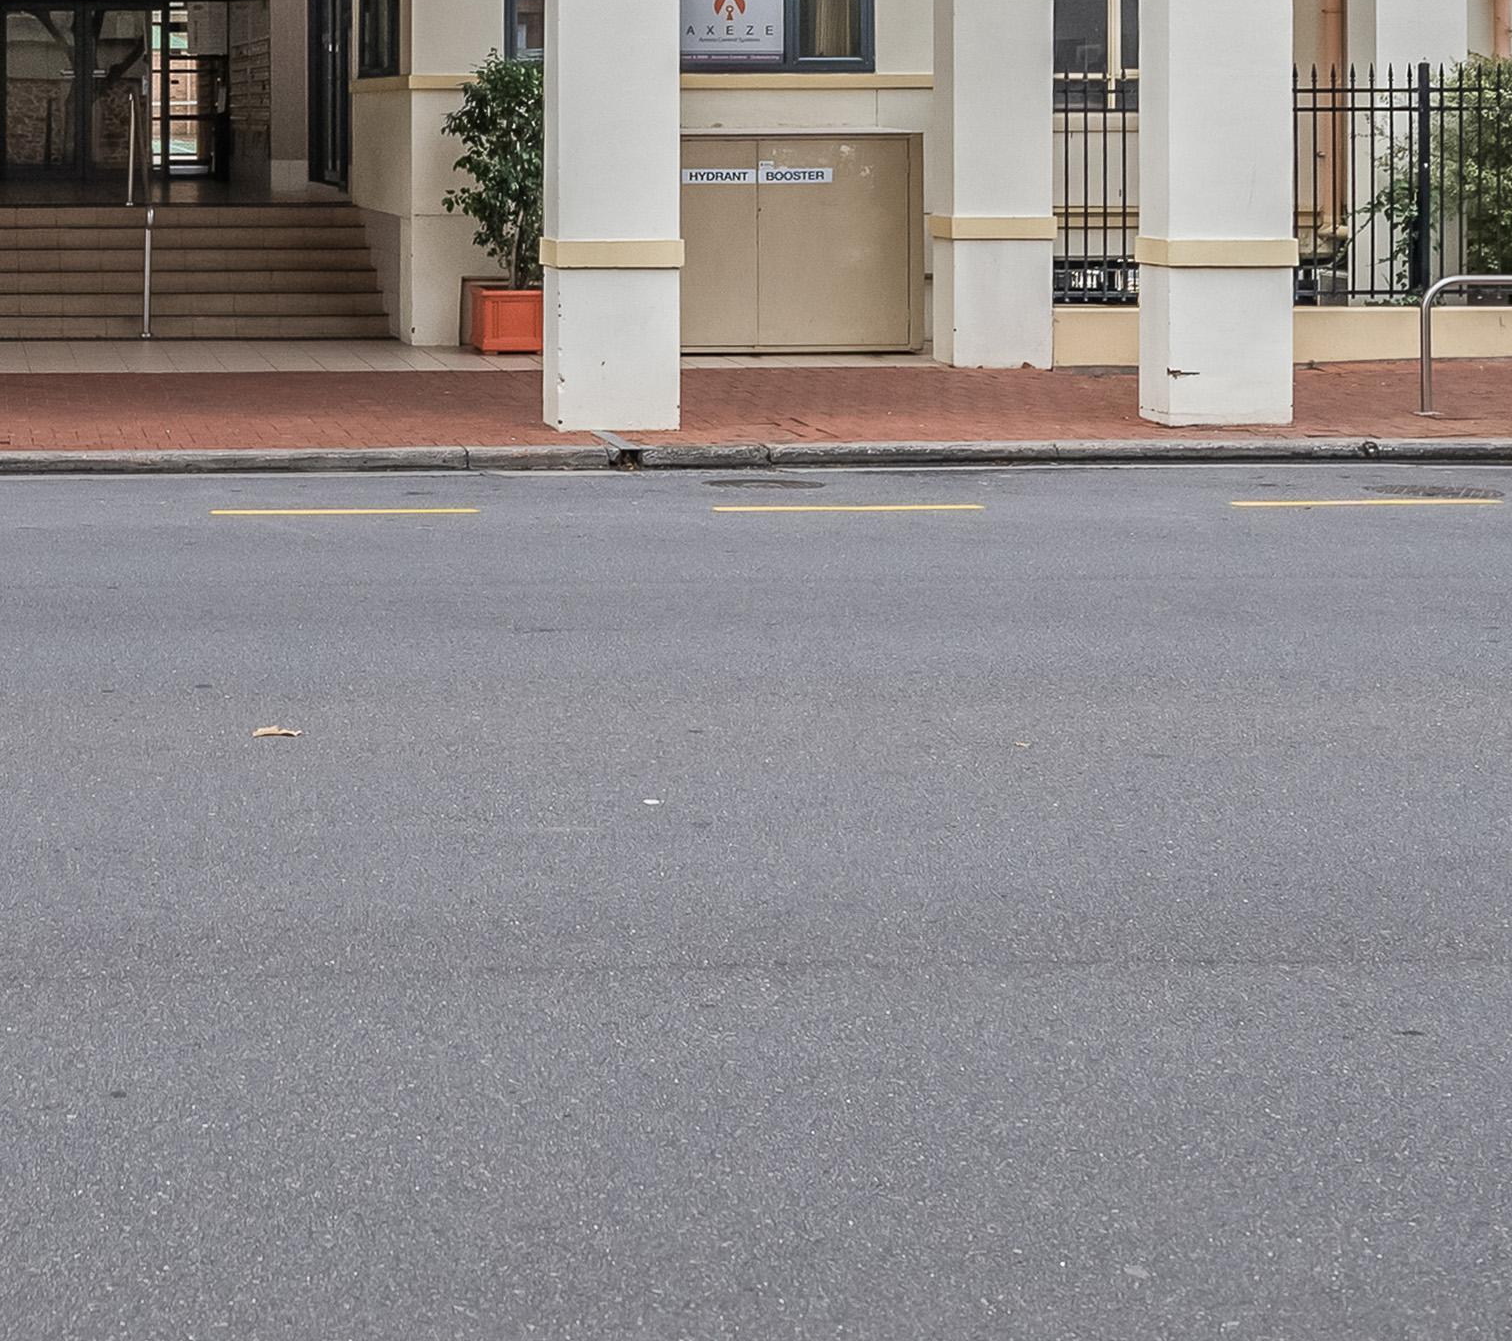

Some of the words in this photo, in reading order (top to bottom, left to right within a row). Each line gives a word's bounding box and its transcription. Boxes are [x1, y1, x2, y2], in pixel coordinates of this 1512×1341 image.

[686, 25, 774, 36] AXEZE
[689, 171, 749, 182] HYDRANT
[766, 171, 825, 181] BOOSTER
